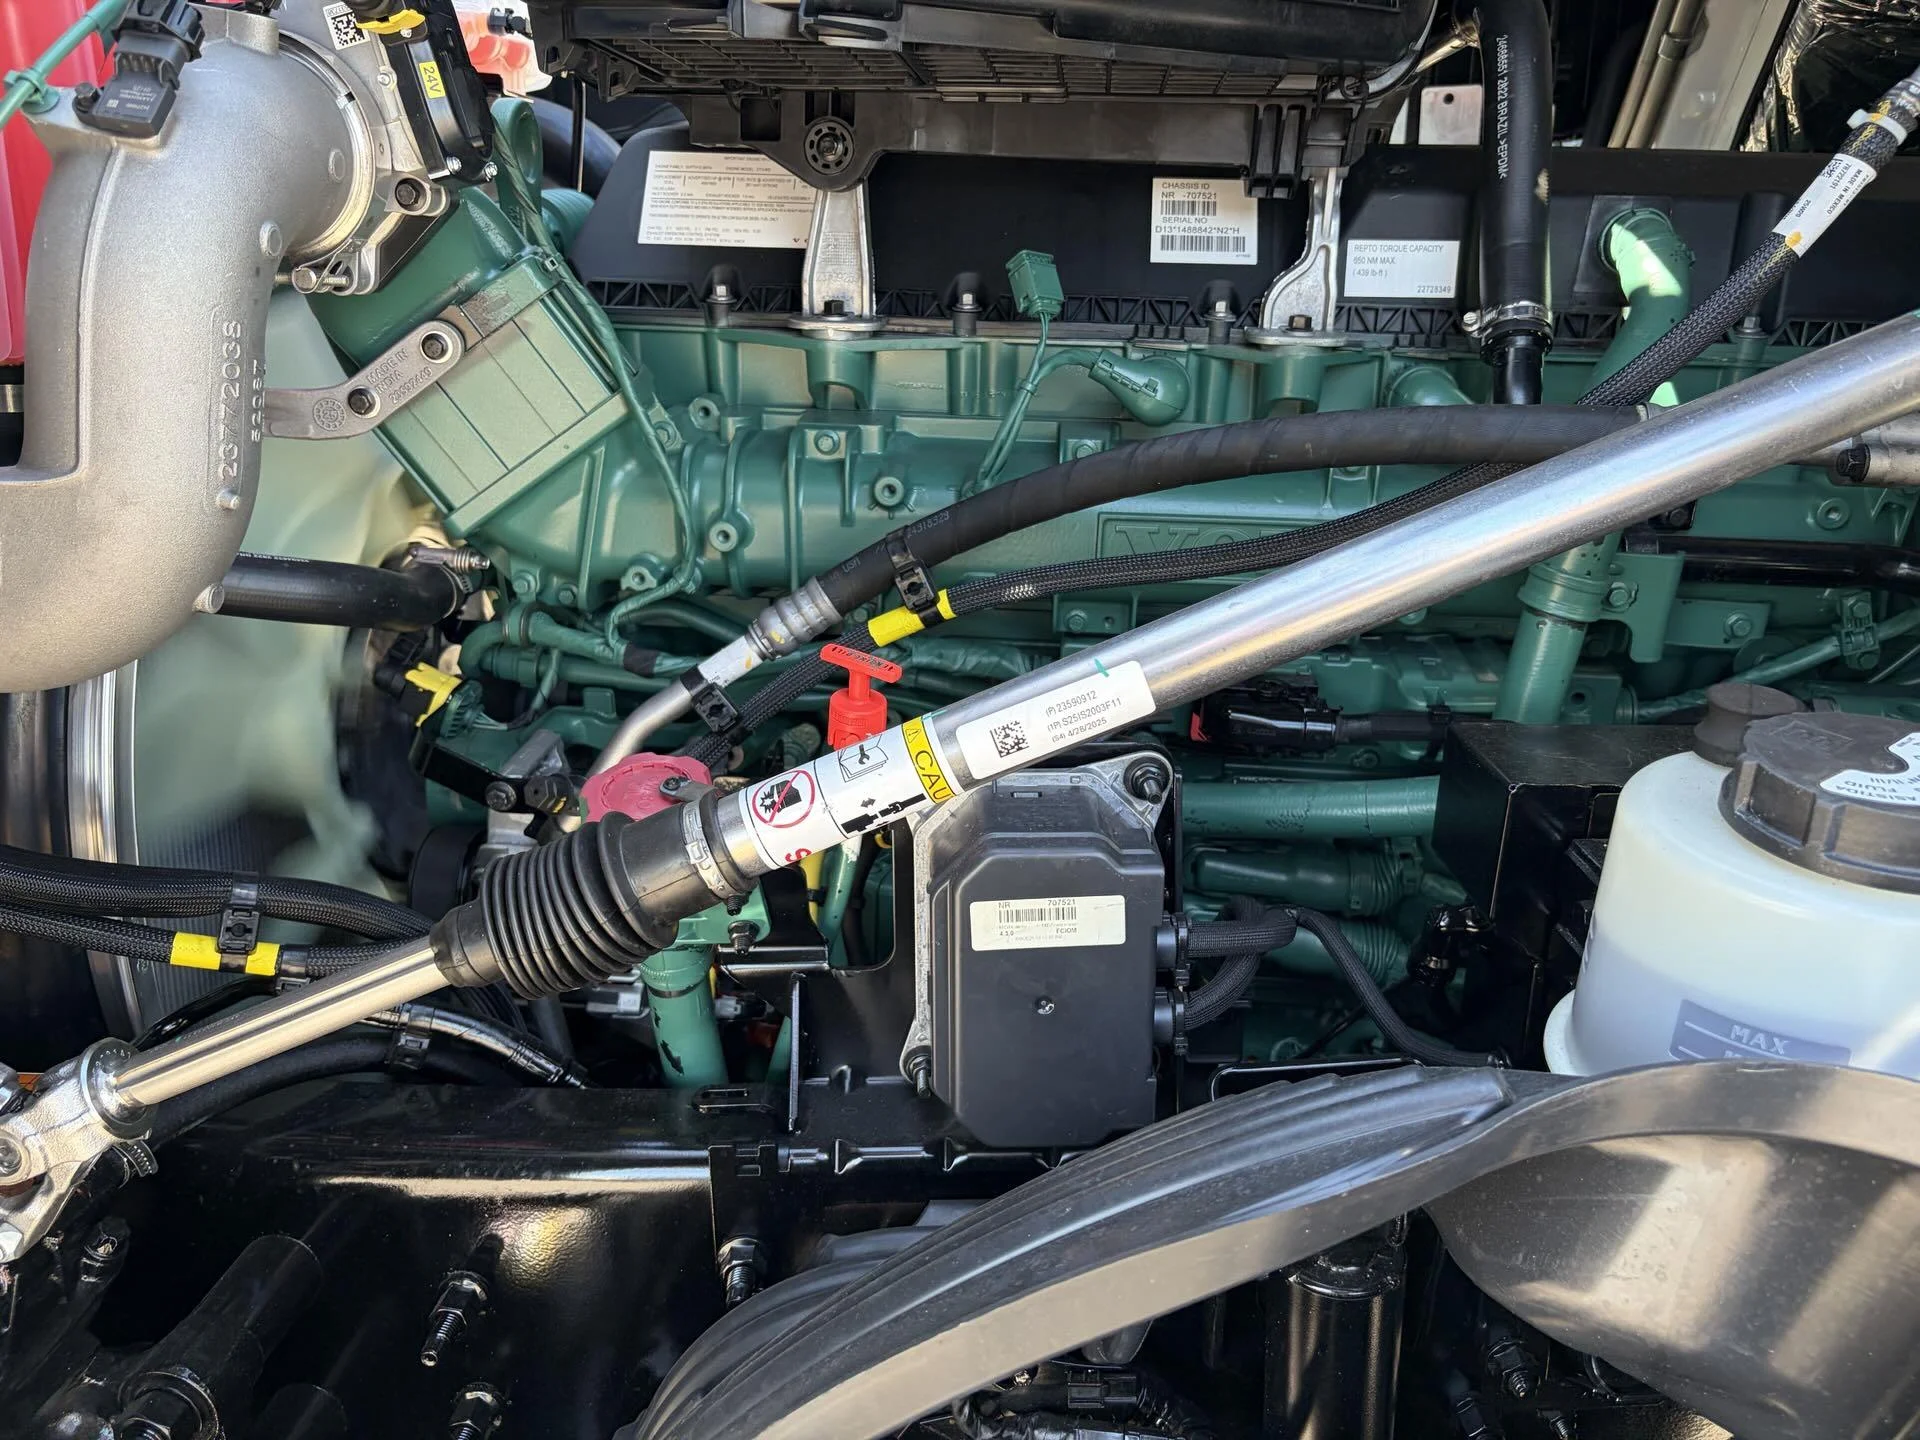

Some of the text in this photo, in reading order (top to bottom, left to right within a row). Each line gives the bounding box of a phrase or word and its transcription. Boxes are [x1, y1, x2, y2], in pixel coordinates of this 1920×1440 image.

[423, 66, 441, 93] 24V
[1497, 101, 1509, 139] BRAZIL
[1161, 182, 1210, 190] CHASSIS ID
[1849, 169, 1863, 186] MADE
[1161, 191, 1175, 199] NR
[1842, 186, 1851, 194] IN
[1827, 194, 1845, 215] MEXICO
[1162, 216, 1208, 225] SERIAL NO
[1353, 244, 1444, 253] REPTO TORQUE CAPACITY
[1367, 257, 1379, 265] NM
[366, 347, 409, 385] MADE IN
[375, 369, 403, 395] INDIA
[1056, 690, 1097, 713] 23590912
[1048, 898, 1077, 906] 707521
[1730, 1023, 1789, 1056] MAX
